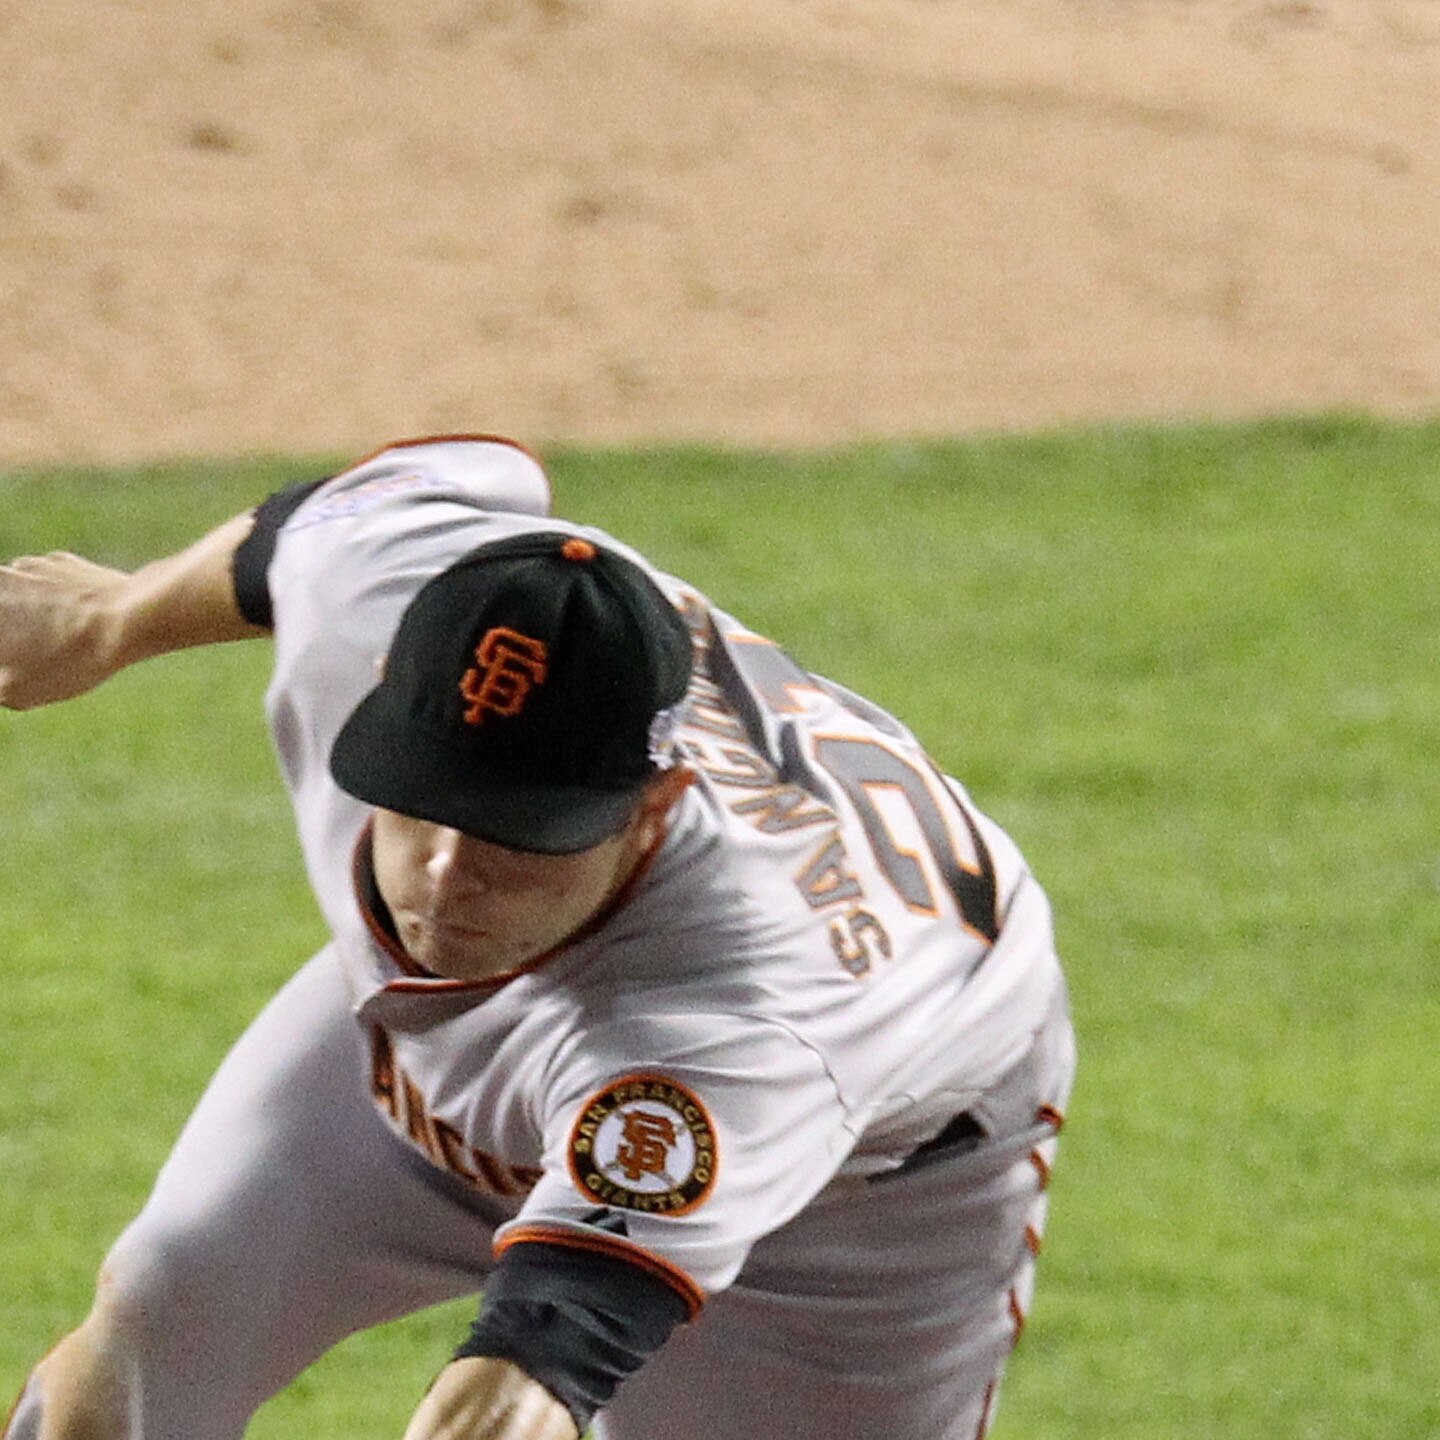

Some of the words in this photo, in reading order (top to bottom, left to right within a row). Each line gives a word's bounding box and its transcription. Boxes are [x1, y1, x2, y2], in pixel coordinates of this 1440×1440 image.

[459, 627, 548, 726] SF
[574, 1104, 608, 1153] SAN
[613, 1082, 712, 1184] FRANCISCO
[585, 1172, 686, 1210] GIANTS
